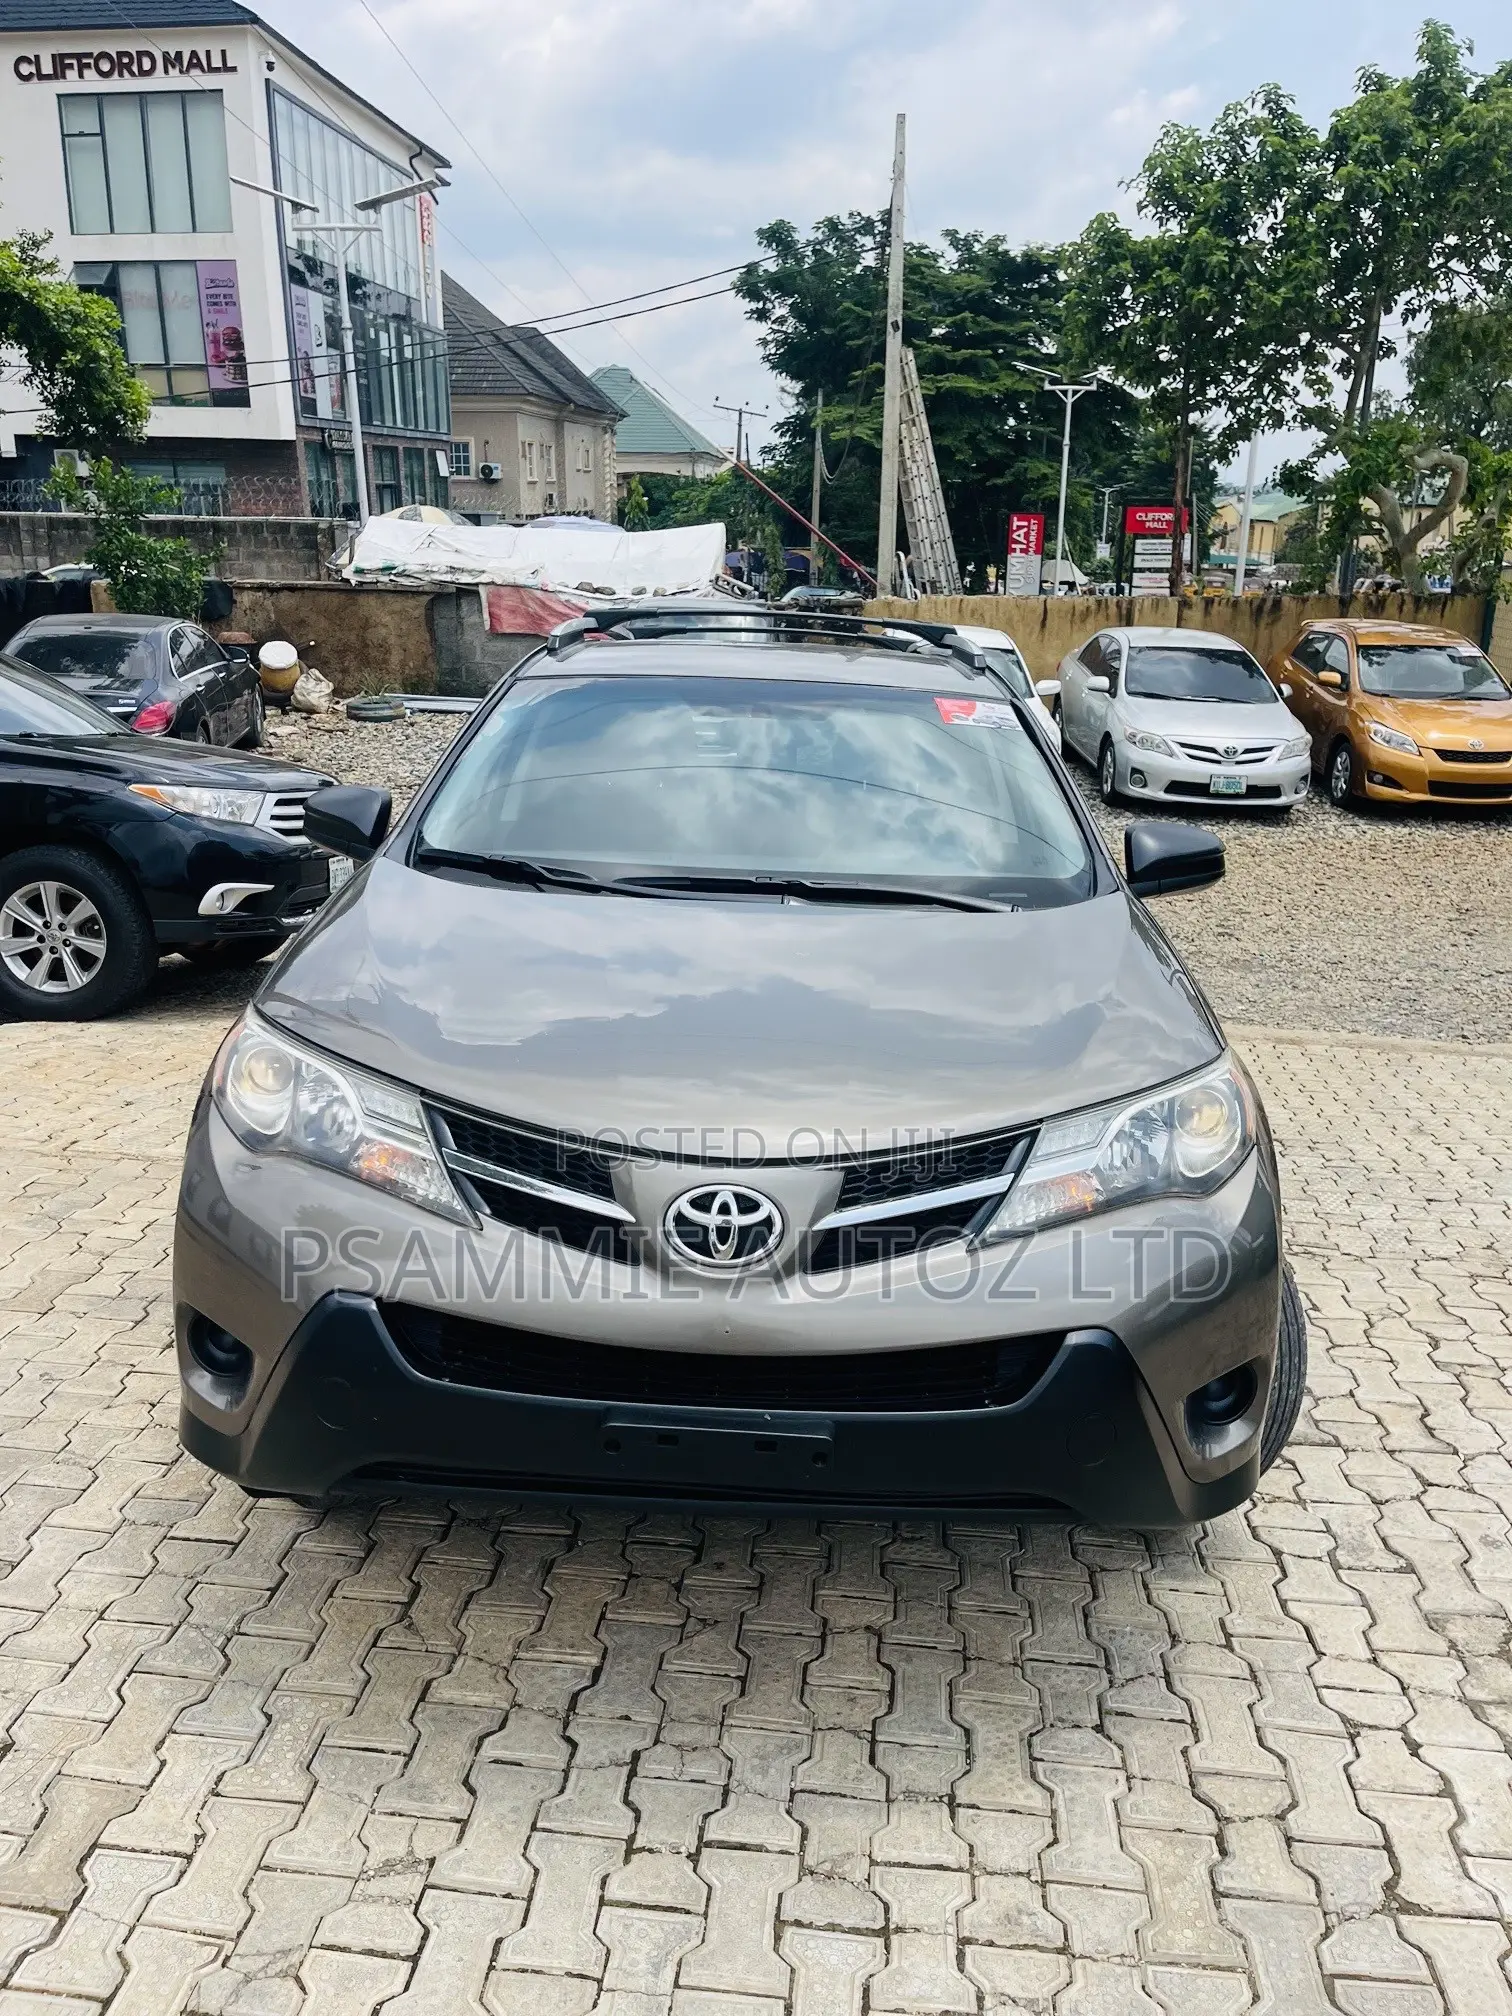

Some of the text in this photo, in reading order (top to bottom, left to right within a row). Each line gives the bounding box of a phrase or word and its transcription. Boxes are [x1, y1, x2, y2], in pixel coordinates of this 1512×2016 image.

[13, 49, 238, 82] CLIFFORD MALL
[1135, 512, 1174, 521] CLIFFOR
[1145, 521, 1168, 529] MALL
